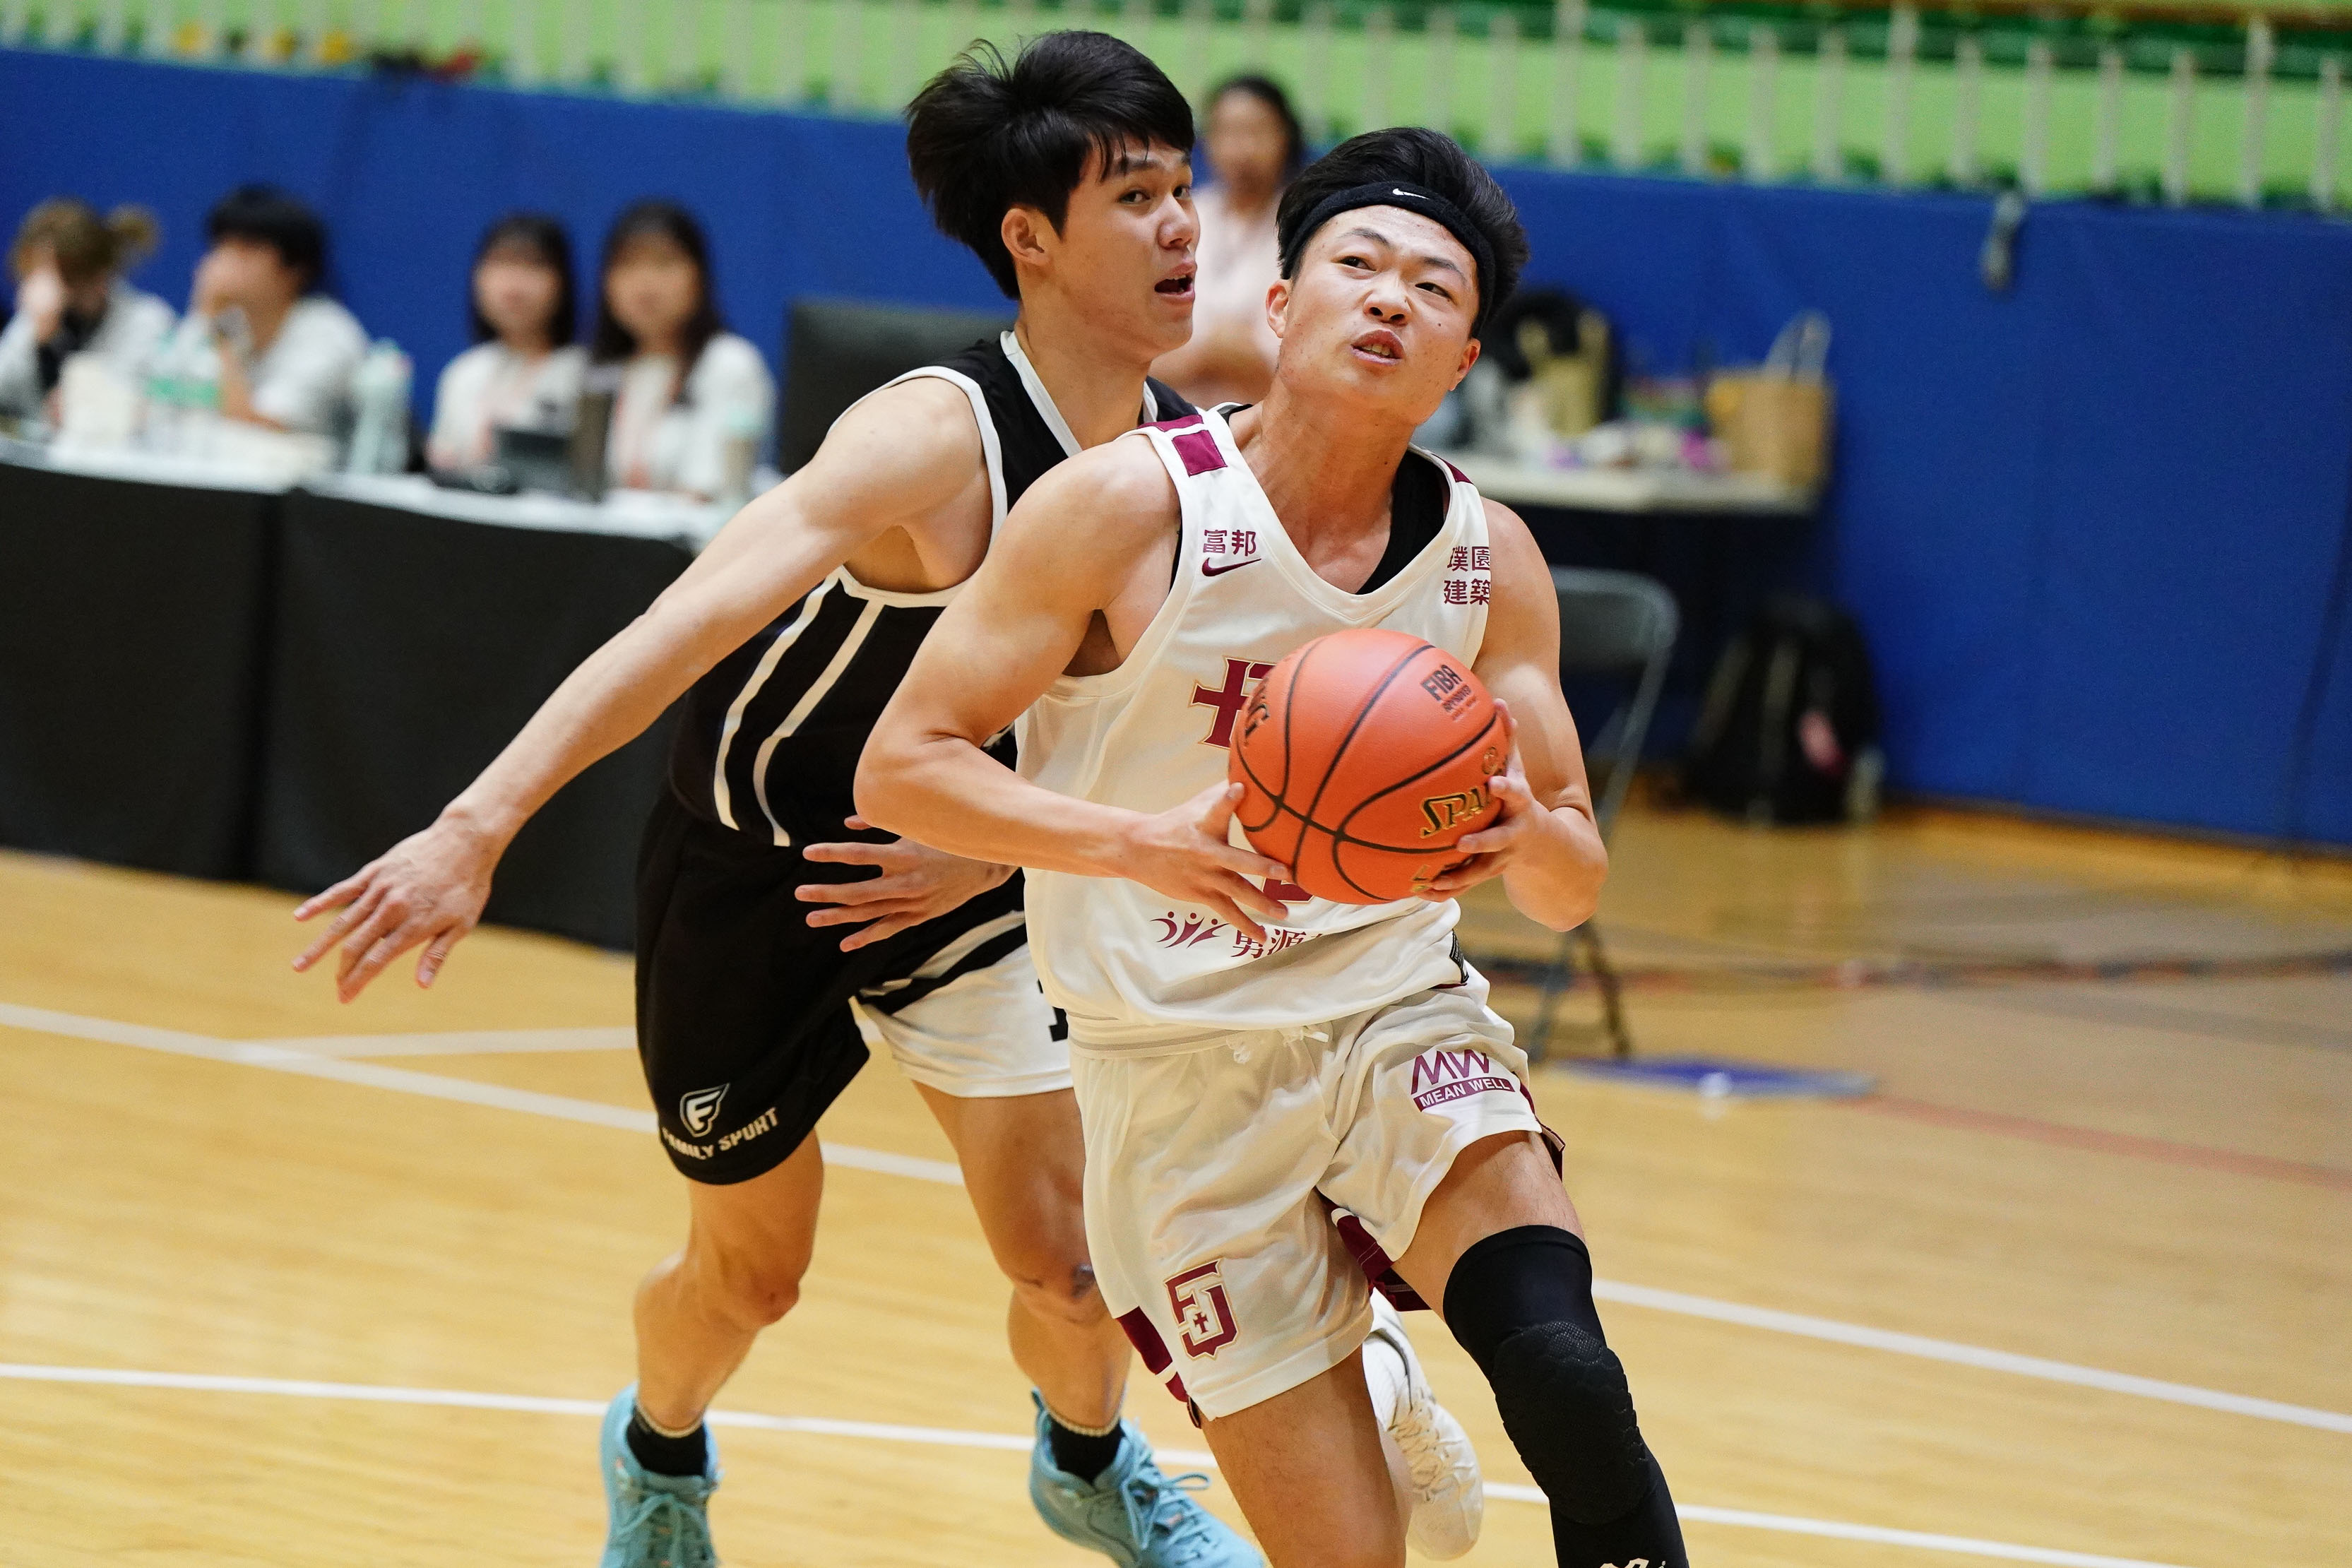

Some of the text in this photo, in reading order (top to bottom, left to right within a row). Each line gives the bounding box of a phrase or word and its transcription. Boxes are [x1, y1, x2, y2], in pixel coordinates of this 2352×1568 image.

[1203, 530, 1257, 557] 富邦
[1443, 578, 1491, 605] 建築
[1421, 664, 1463, 701] FIBA
[1411, 1049, 1490, 1095] MW
[1419, 1078, 1511, 1107] MEAN WELL
[718, 1106, 778, 1152] SPORT
